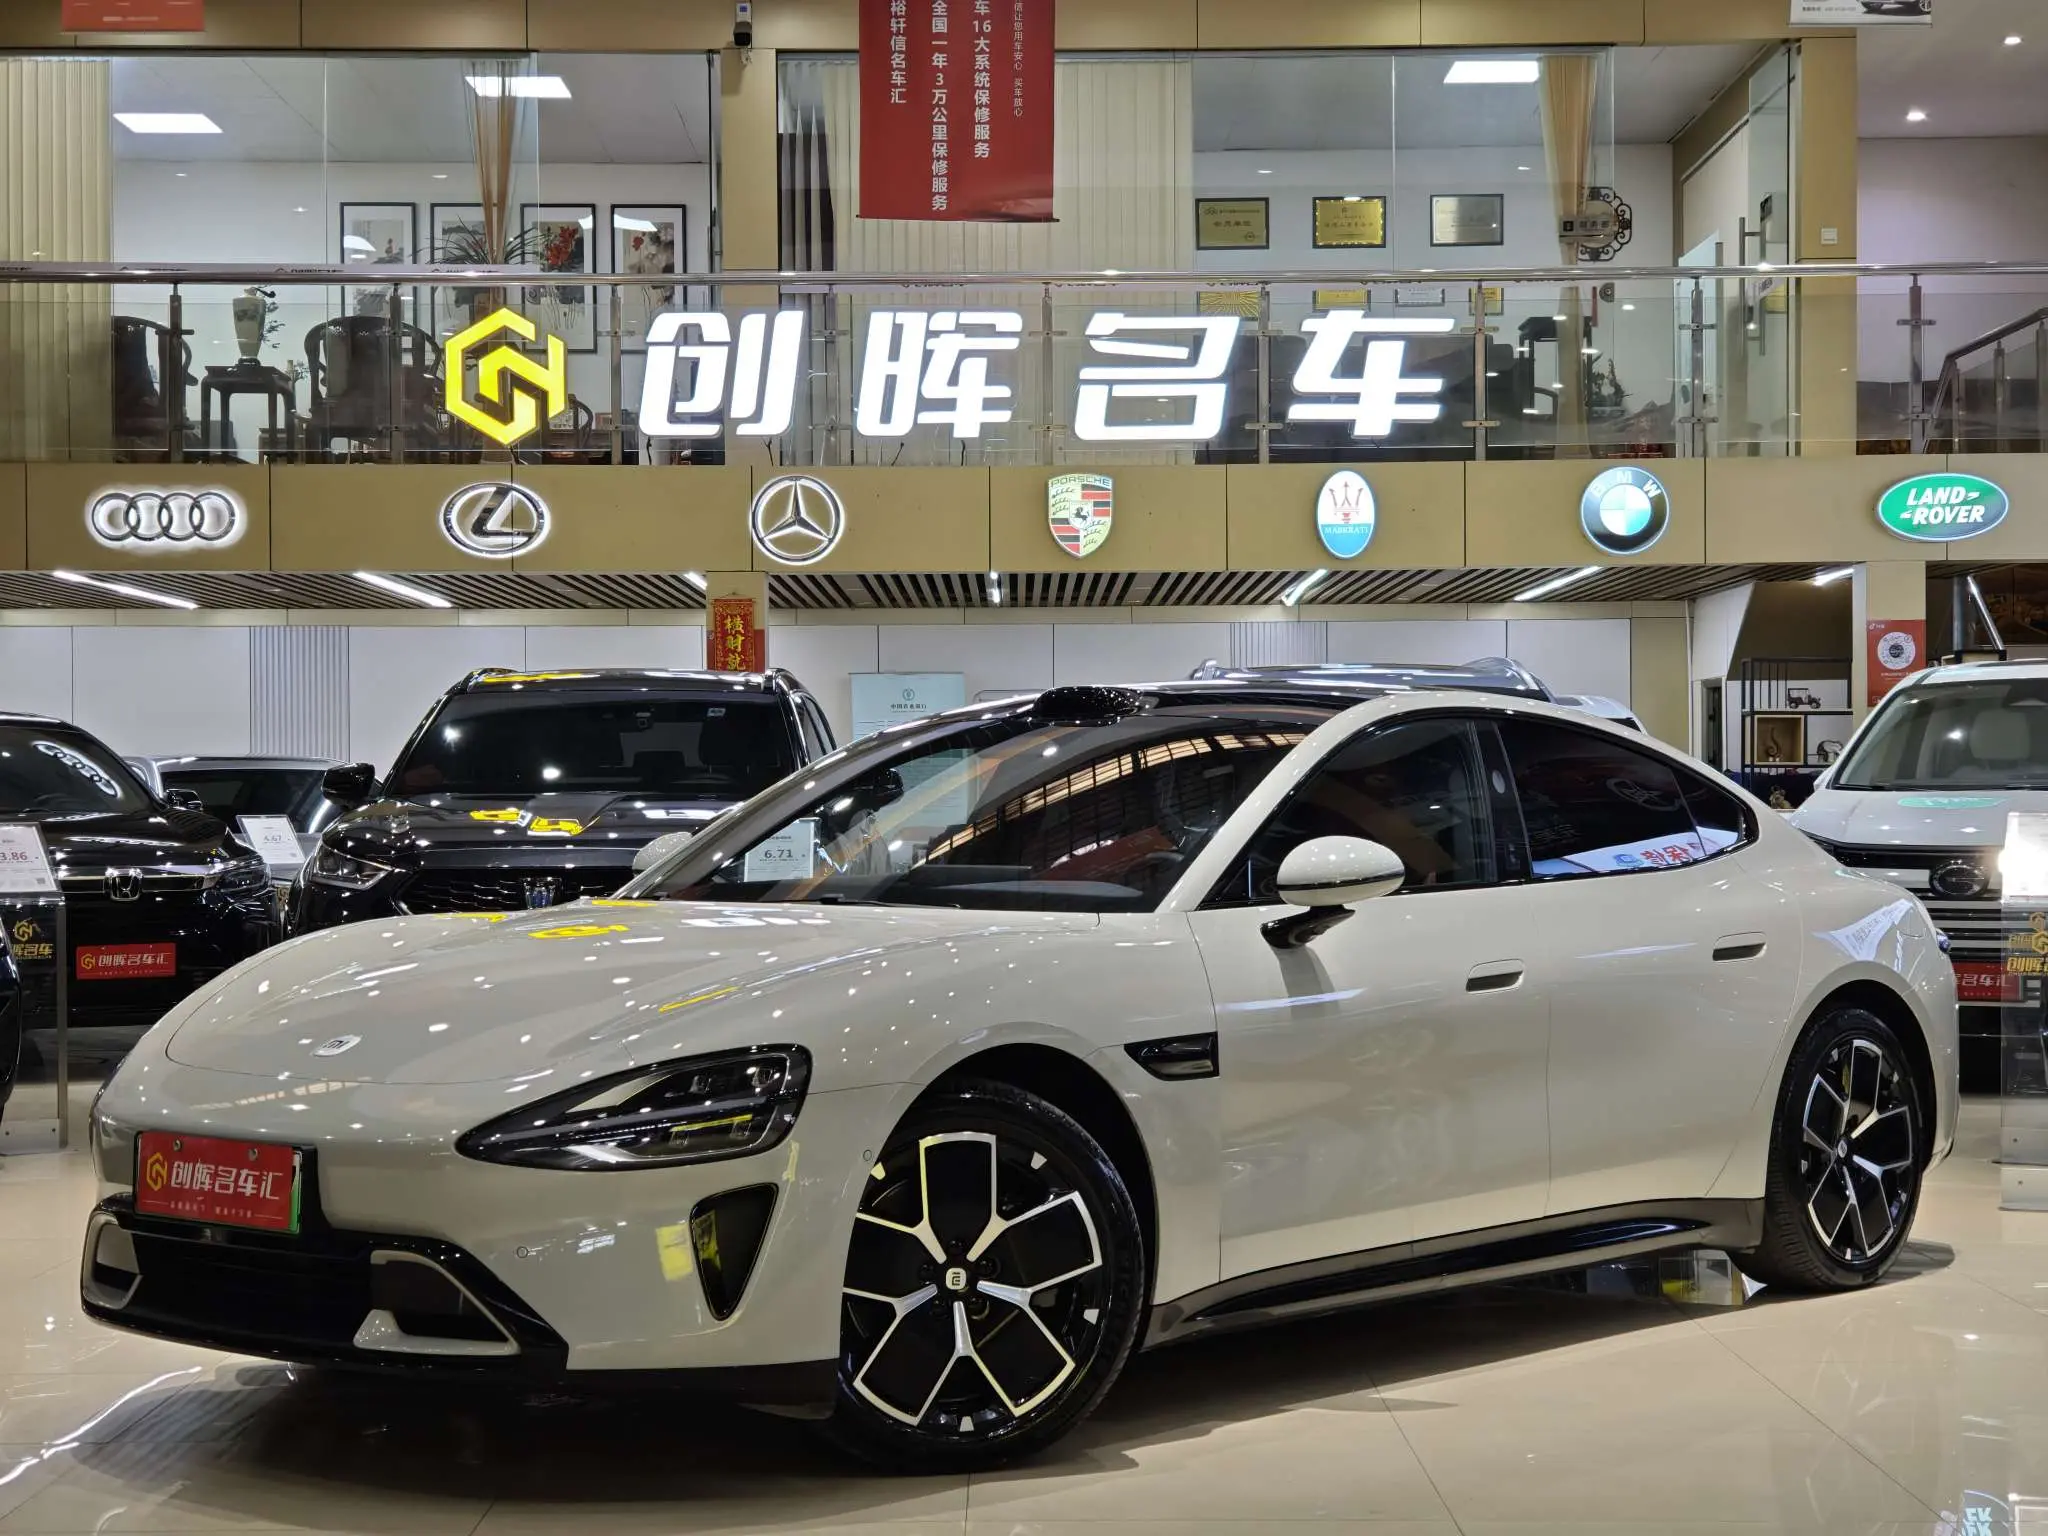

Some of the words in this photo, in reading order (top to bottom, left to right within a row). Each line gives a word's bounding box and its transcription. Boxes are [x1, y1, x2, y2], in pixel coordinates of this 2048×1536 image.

[931, 0, 948, 211] 全国一年3万公里保修服务
[639, 309, 1455, 441] 创晖名车
[1051, 475, 1110, 487] PORSCHE
[1589, 470, 1662, 498] BMW
[1906, 486, 1967, 505] LAND
[1912, 505, 1985, 525] ROVER
[764, 849, 794, 859] 6.71
[98, 952, 172, 967] 创晖名车汇
[170, 1159, 284, 1200] 创晖名车汇
